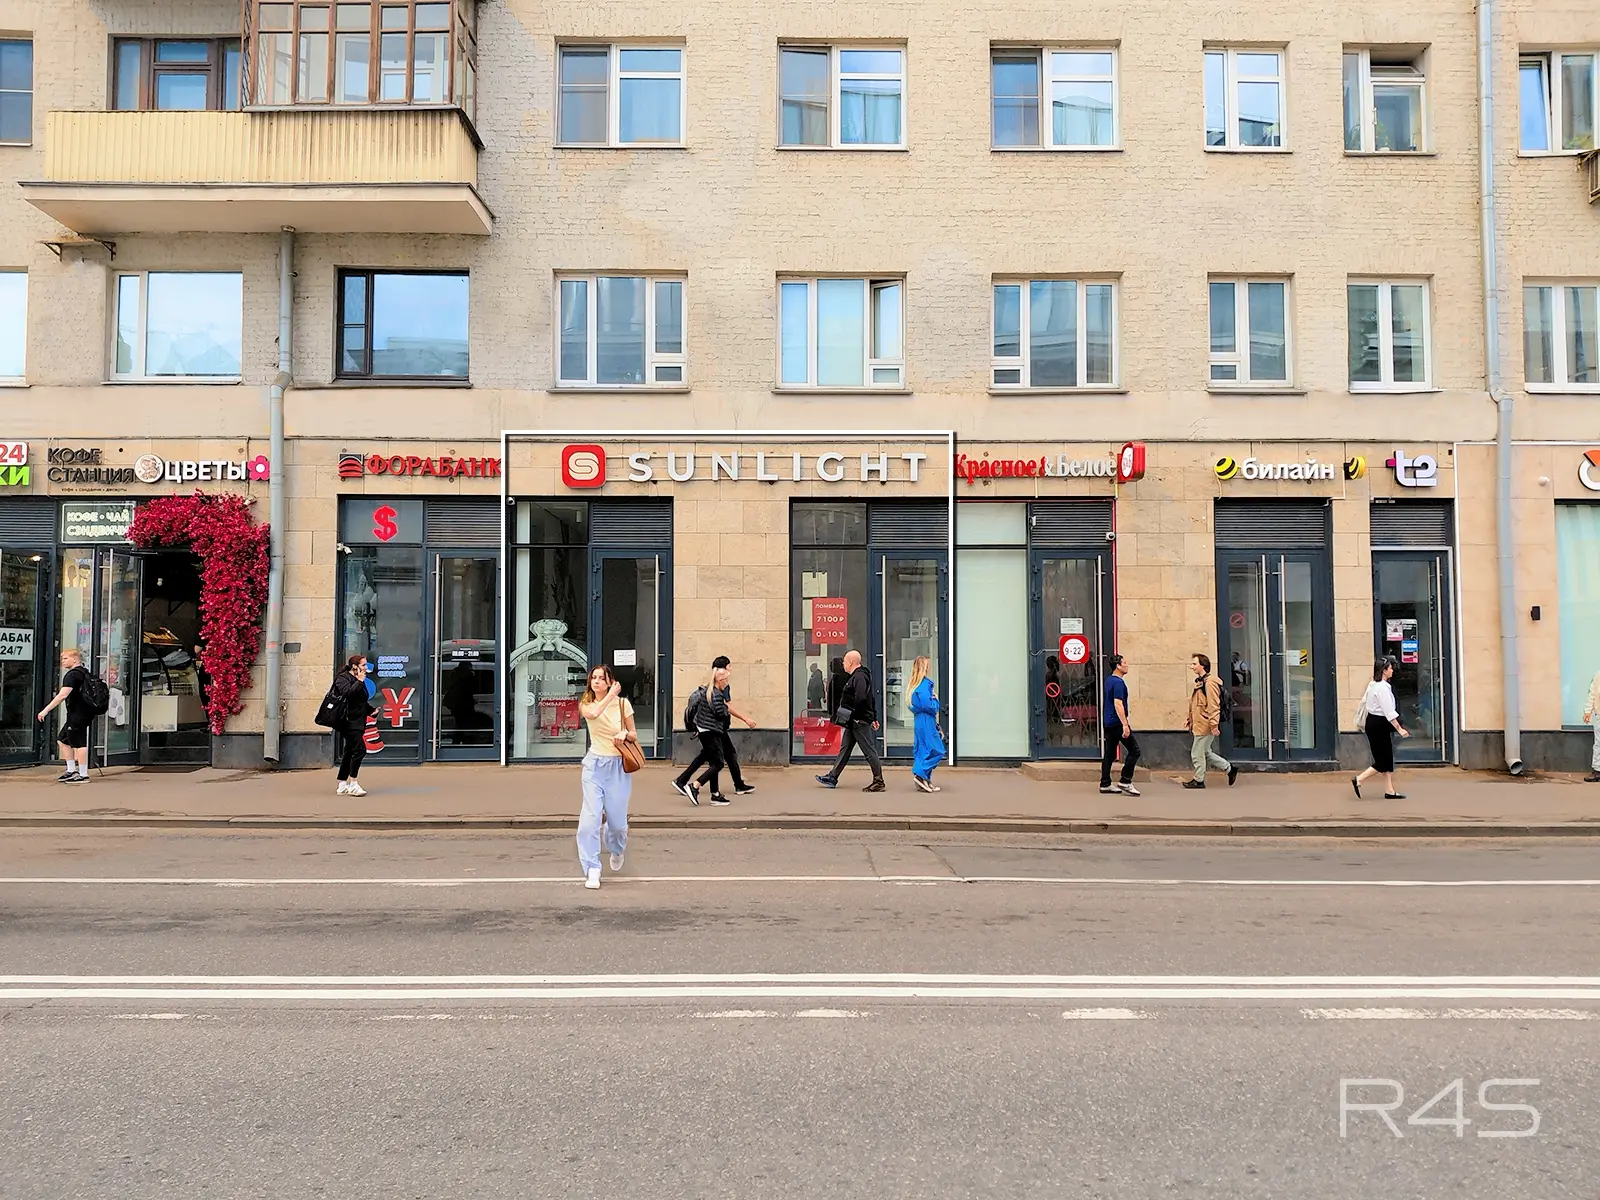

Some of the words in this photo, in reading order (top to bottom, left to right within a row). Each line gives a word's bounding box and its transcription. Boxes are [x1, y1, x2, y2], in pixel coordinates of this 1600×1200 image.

[47, 447, 103, 464] КОФЕ
[47, 466, 136, 484] СТАНЦИЯ
[164, 460, 246, 483] ЦВЕТЫ
[366, 454, 501, 478] ФОРАБАНК
[628, 451, 927, 483] SUNLIGHT
[953, 453, 1037, 485] Красное
[1057, 453, 1118, 477] Белое
[1241, 456, 1335, 480] билайн
[1393, 450, 1438, 487] t2
[66, 511, 99, 522] КОФЕ
[105, 508, 130, 522] ЧАЙ
[66, 524, 128, 538] СЭНДВИЧИ
[0, 645, 23, 656] 24/7
[521, 674, 579, 682] UNLIGHT
